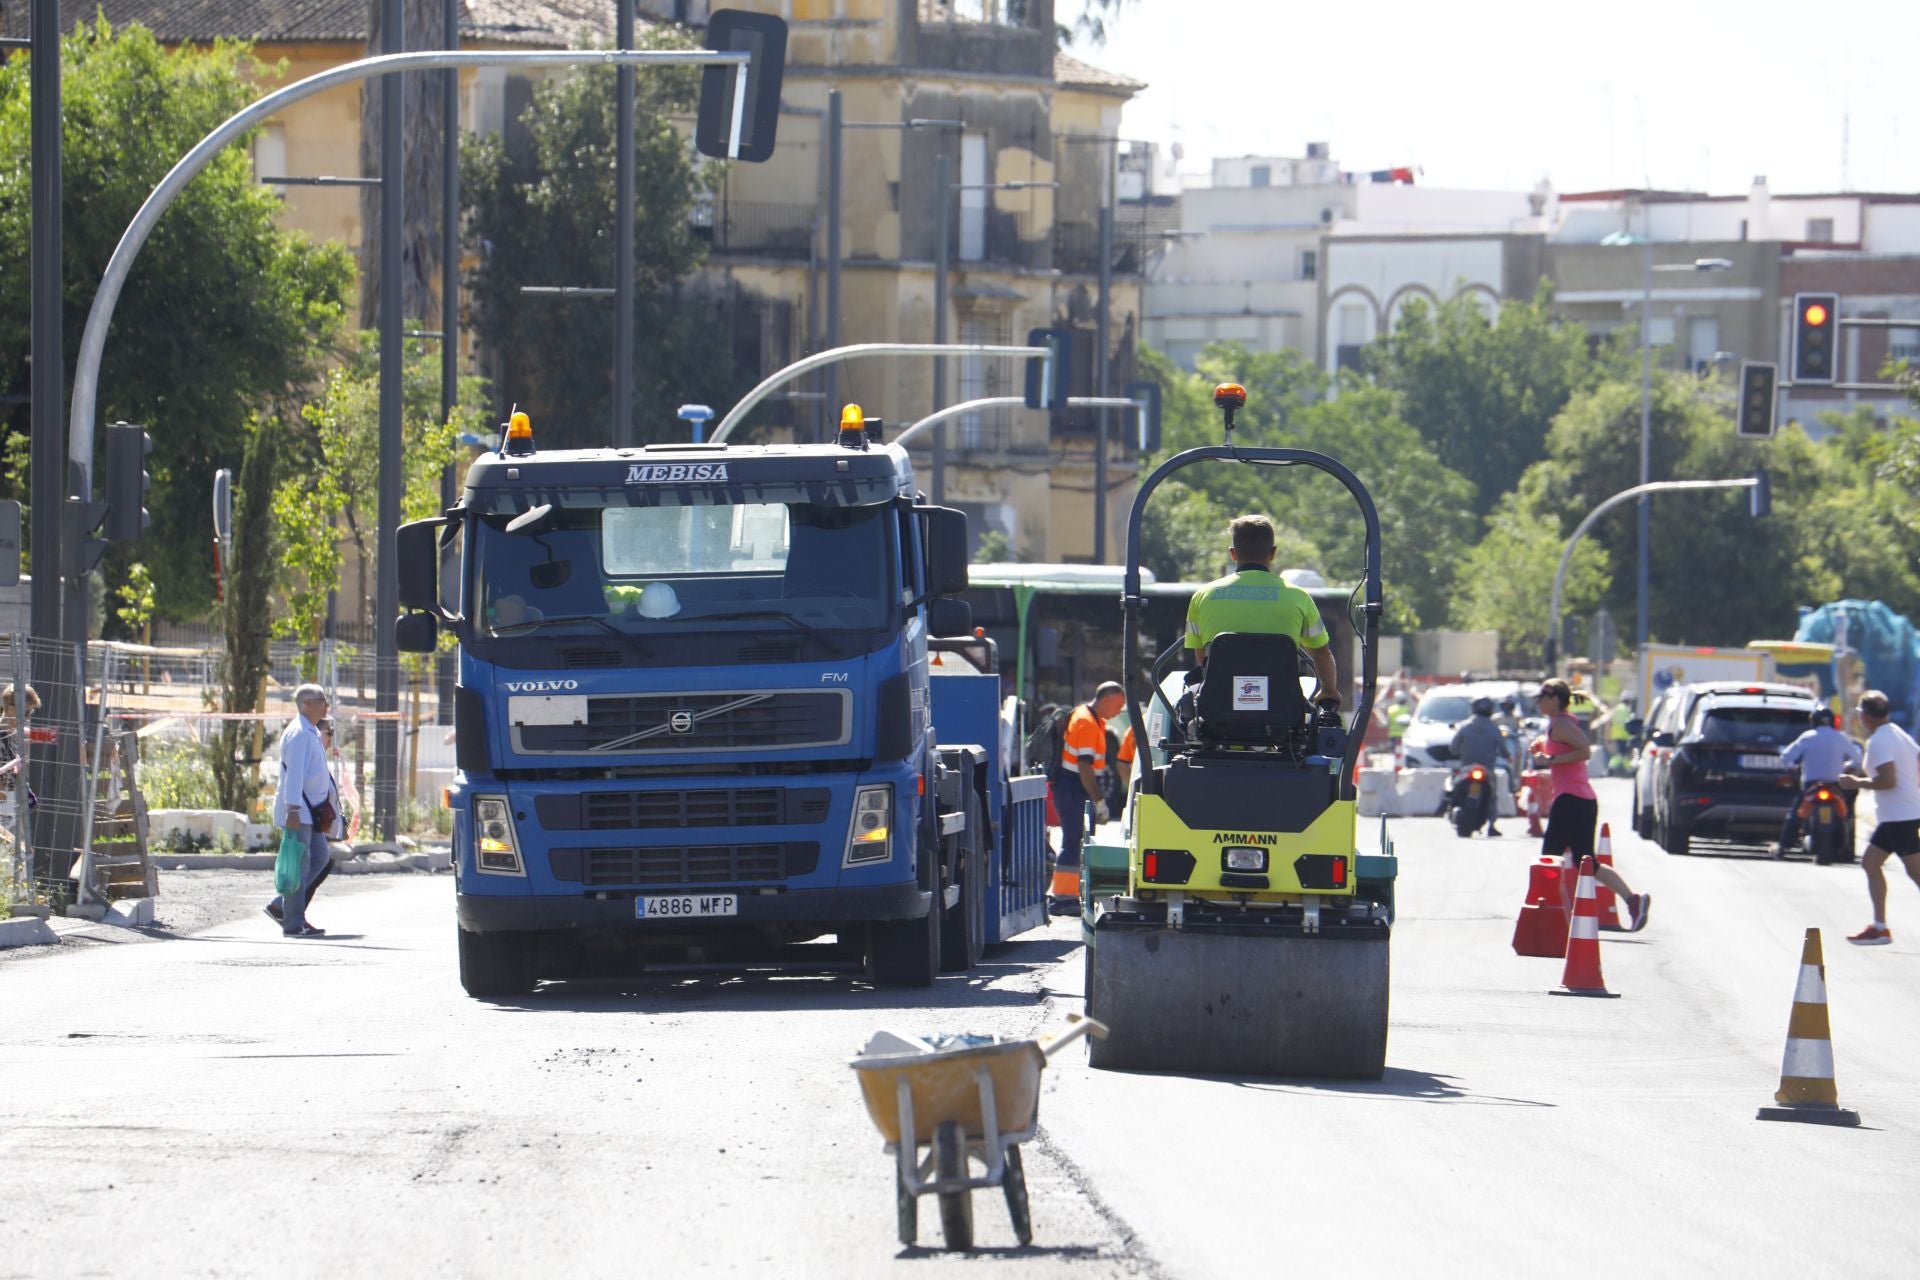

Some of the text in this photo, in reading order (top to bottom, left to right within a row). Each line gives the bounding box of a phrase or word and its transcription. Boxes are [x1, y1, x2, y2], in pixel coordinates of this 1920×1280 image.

[625, 464, 729, 482] MEBISA
[821, 672, 849, 682] FM
[504, 679, 578, 692] VOLVO
[1212, 833, 1277, 845] AMMANN
[648, 897, 733, 915] 4886 MFP
